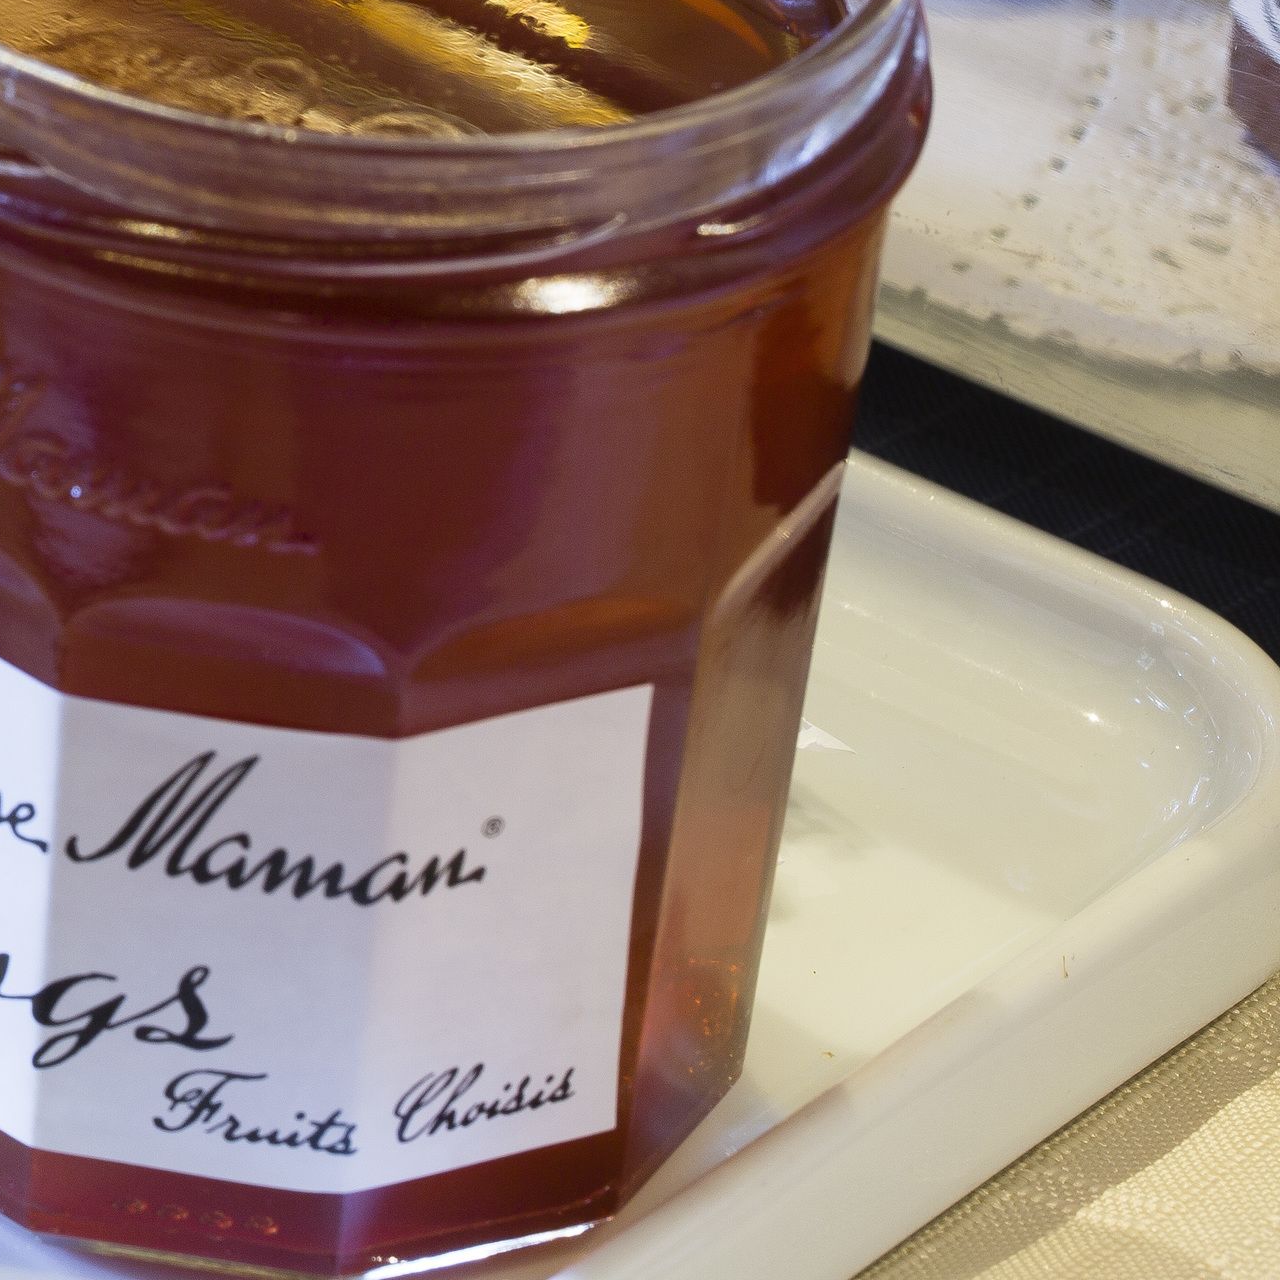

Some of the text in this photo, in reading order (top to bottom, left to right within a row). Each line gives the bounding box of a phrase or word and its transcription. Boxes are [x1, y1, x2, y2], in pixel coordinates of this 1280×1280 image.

[62, 749, 488, 907] Maman
[151, 1062, 577, 1157] Fruits Choisis
